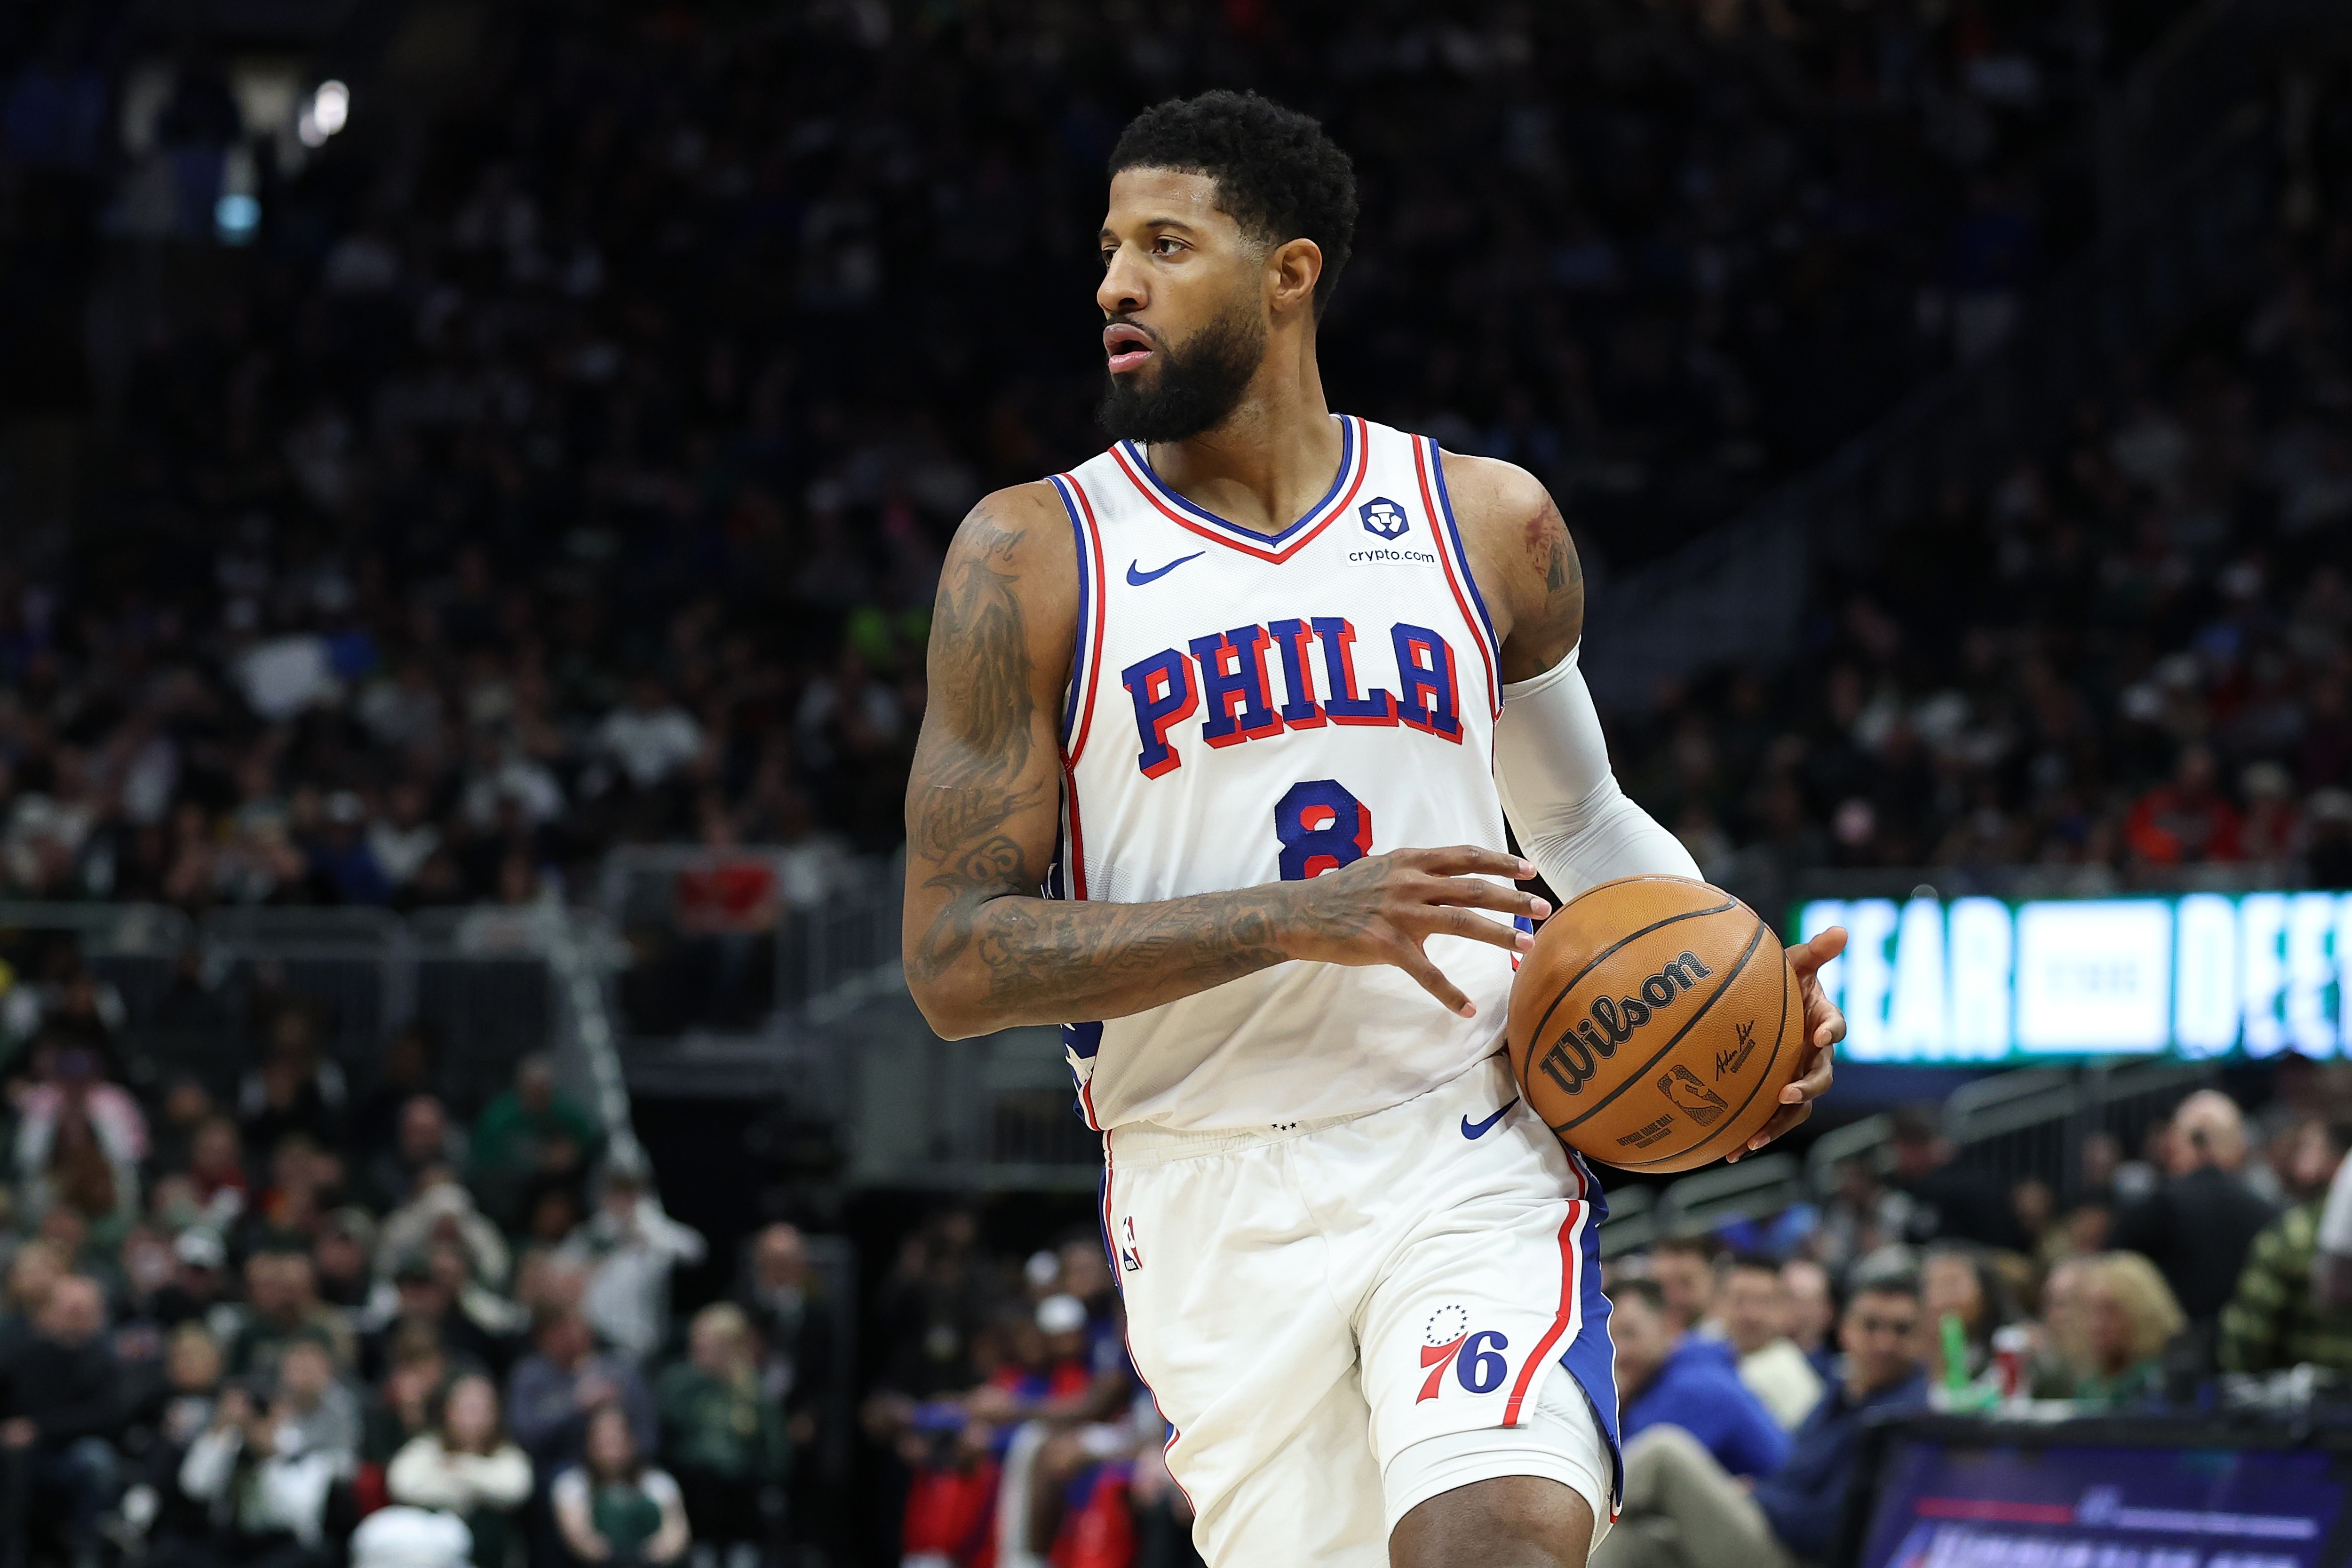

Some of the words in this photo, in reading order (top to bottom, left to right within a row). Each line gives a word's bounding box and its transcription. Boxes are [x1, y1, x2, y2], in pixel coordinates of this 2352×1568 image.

[1349, 548, 1435, 563] crypto.com
[1122, 616, 1463, 780] PHILA
[1274, 779, 1374, 882] 8
[1538, 950, 1714, 1096] Wilson
[2174, 891, 2352, 1060] DEE
[1415, 1330, 1509, 1406] 76
